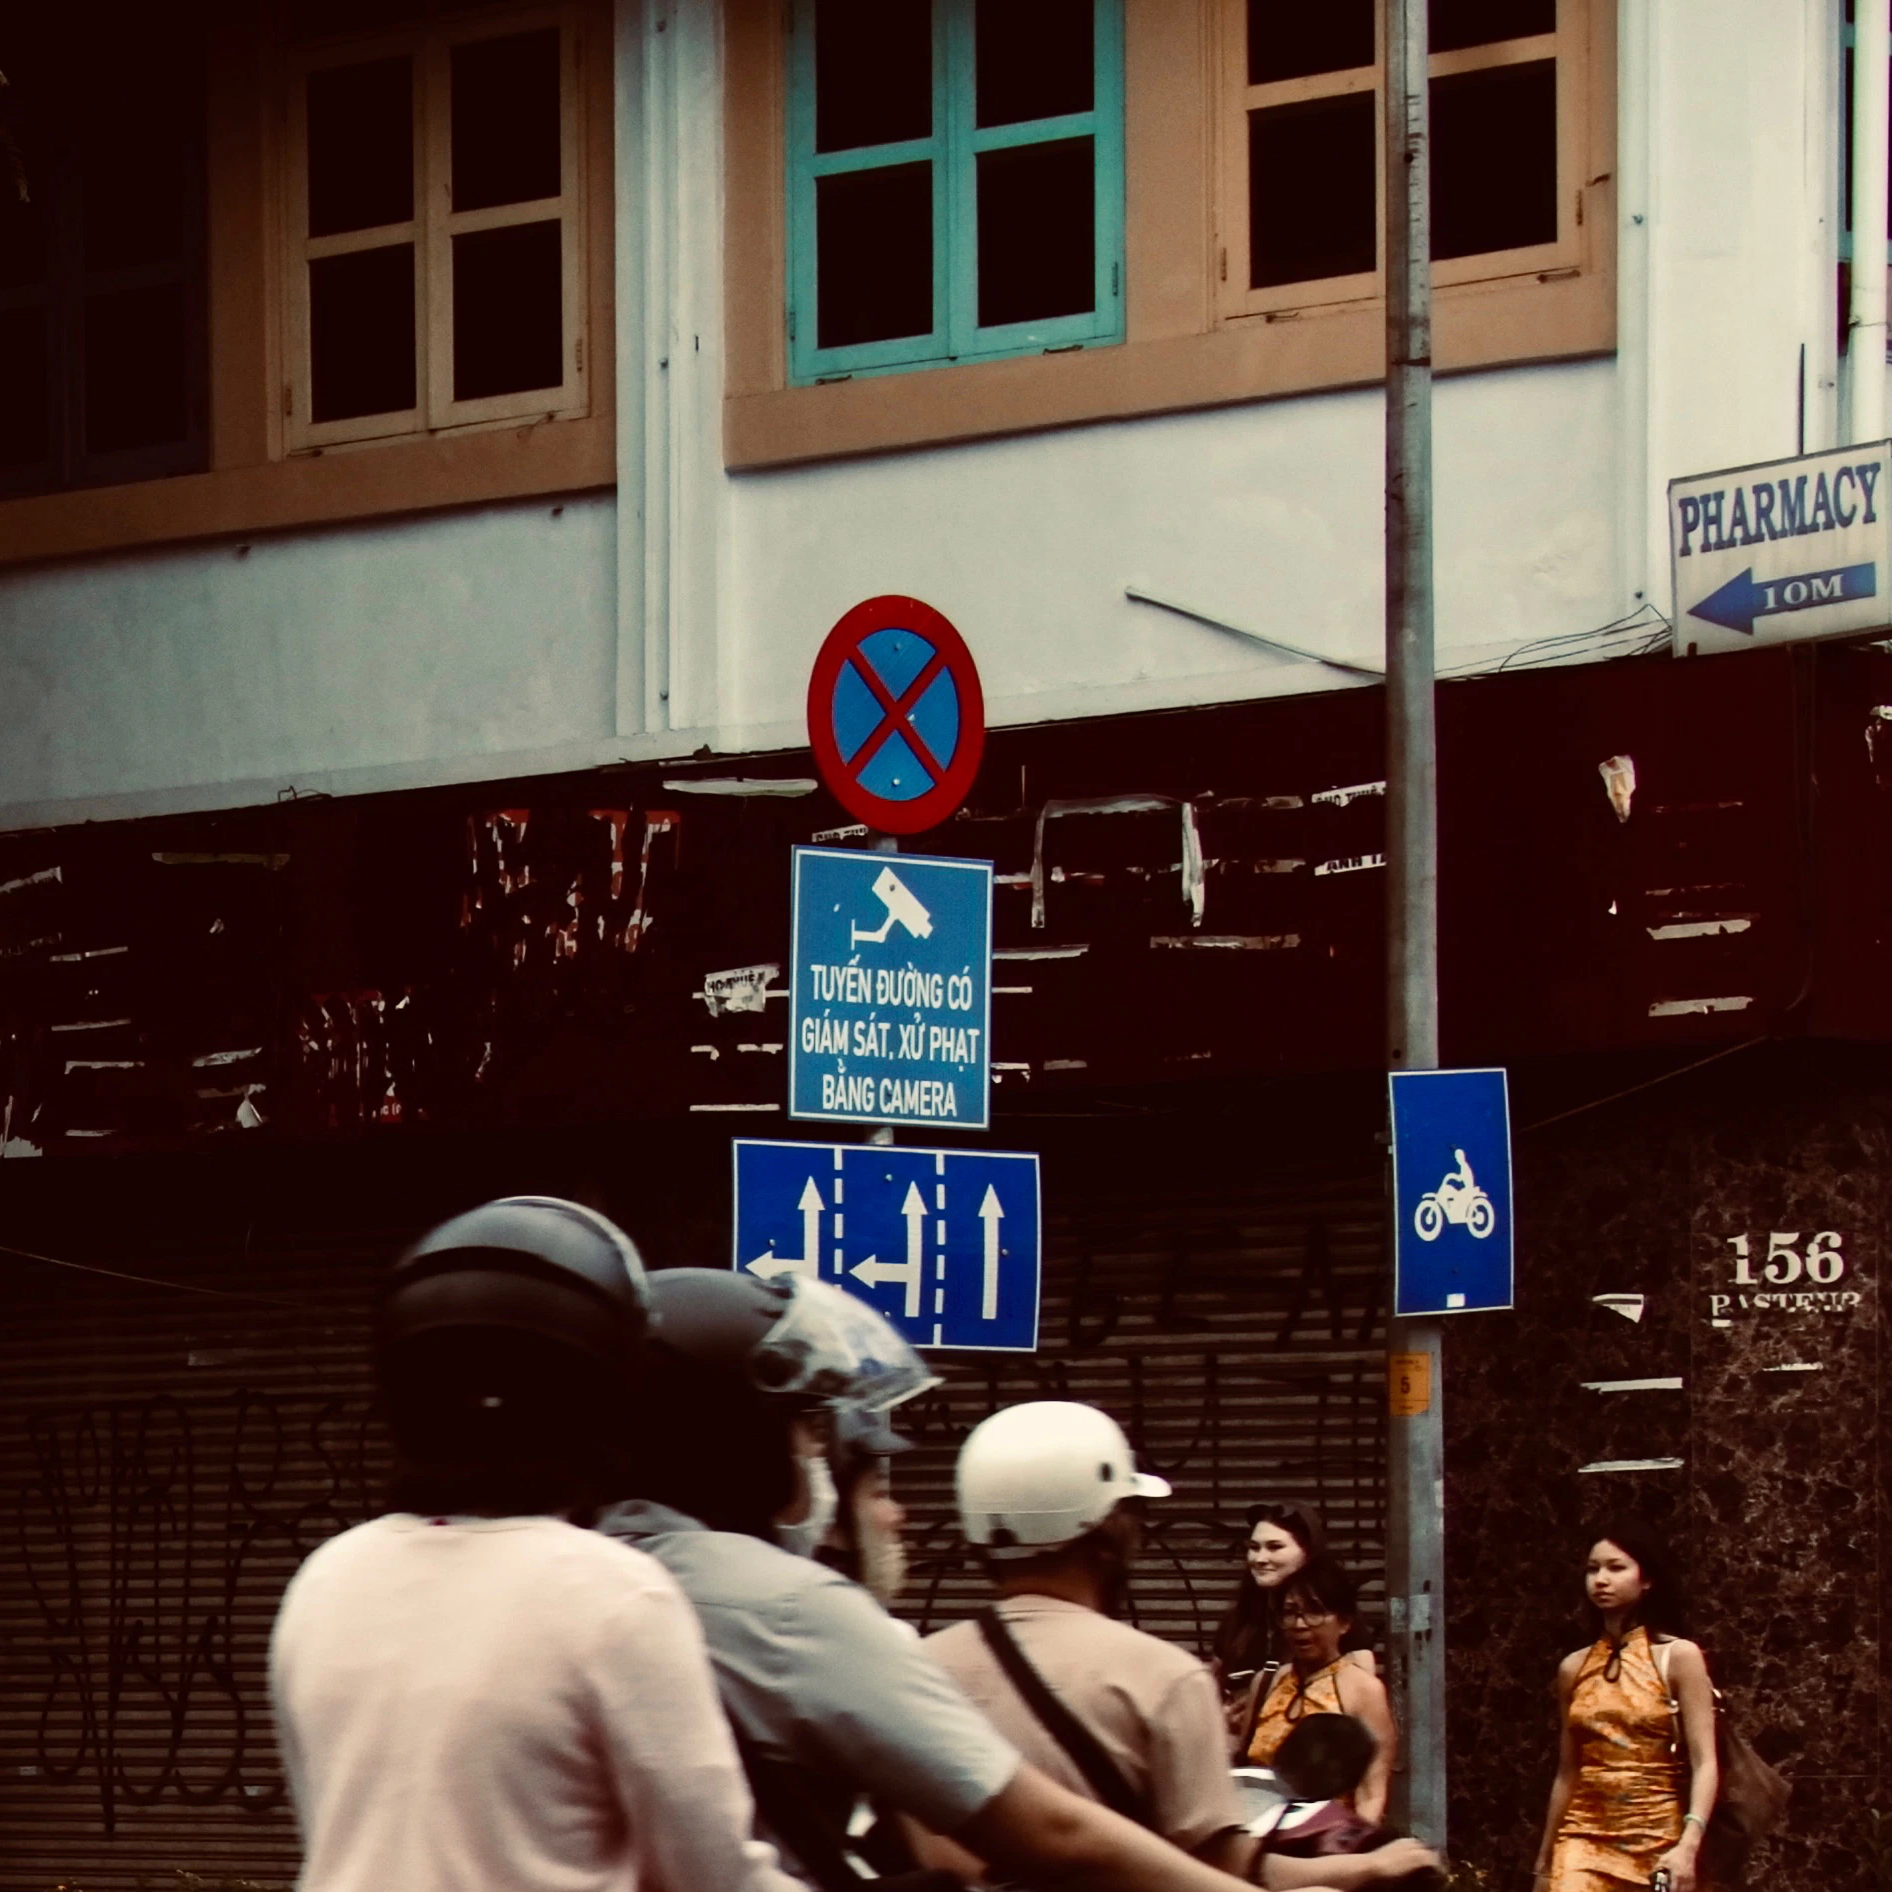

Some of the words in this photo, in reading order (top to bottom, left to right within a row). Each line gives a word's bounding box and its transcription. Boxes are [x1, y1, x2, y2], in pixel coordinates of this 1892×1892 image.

[1678, 462, 1881, 557] PHARMACY
[1764, 574, 1844, 609] 10M
[810, 954, 871, 1003] TUYẾN
[876, 961, 943, 1009] ĐƯỜNG
[948, 965, 972, 1011] CÓ
[801, 1008, 849, 1055] GIÁM
[898, 1012, 926, 1060] XỬ
[929, 1026, 980, 1072] PHẠT
[822, 1058, 875, 1112] BẰNG
[879, 1078, 957, 1117] CAMERA
[1727, 1231, 1844, 1284] 156
[1400, 1376, 1411, 1394] 5
